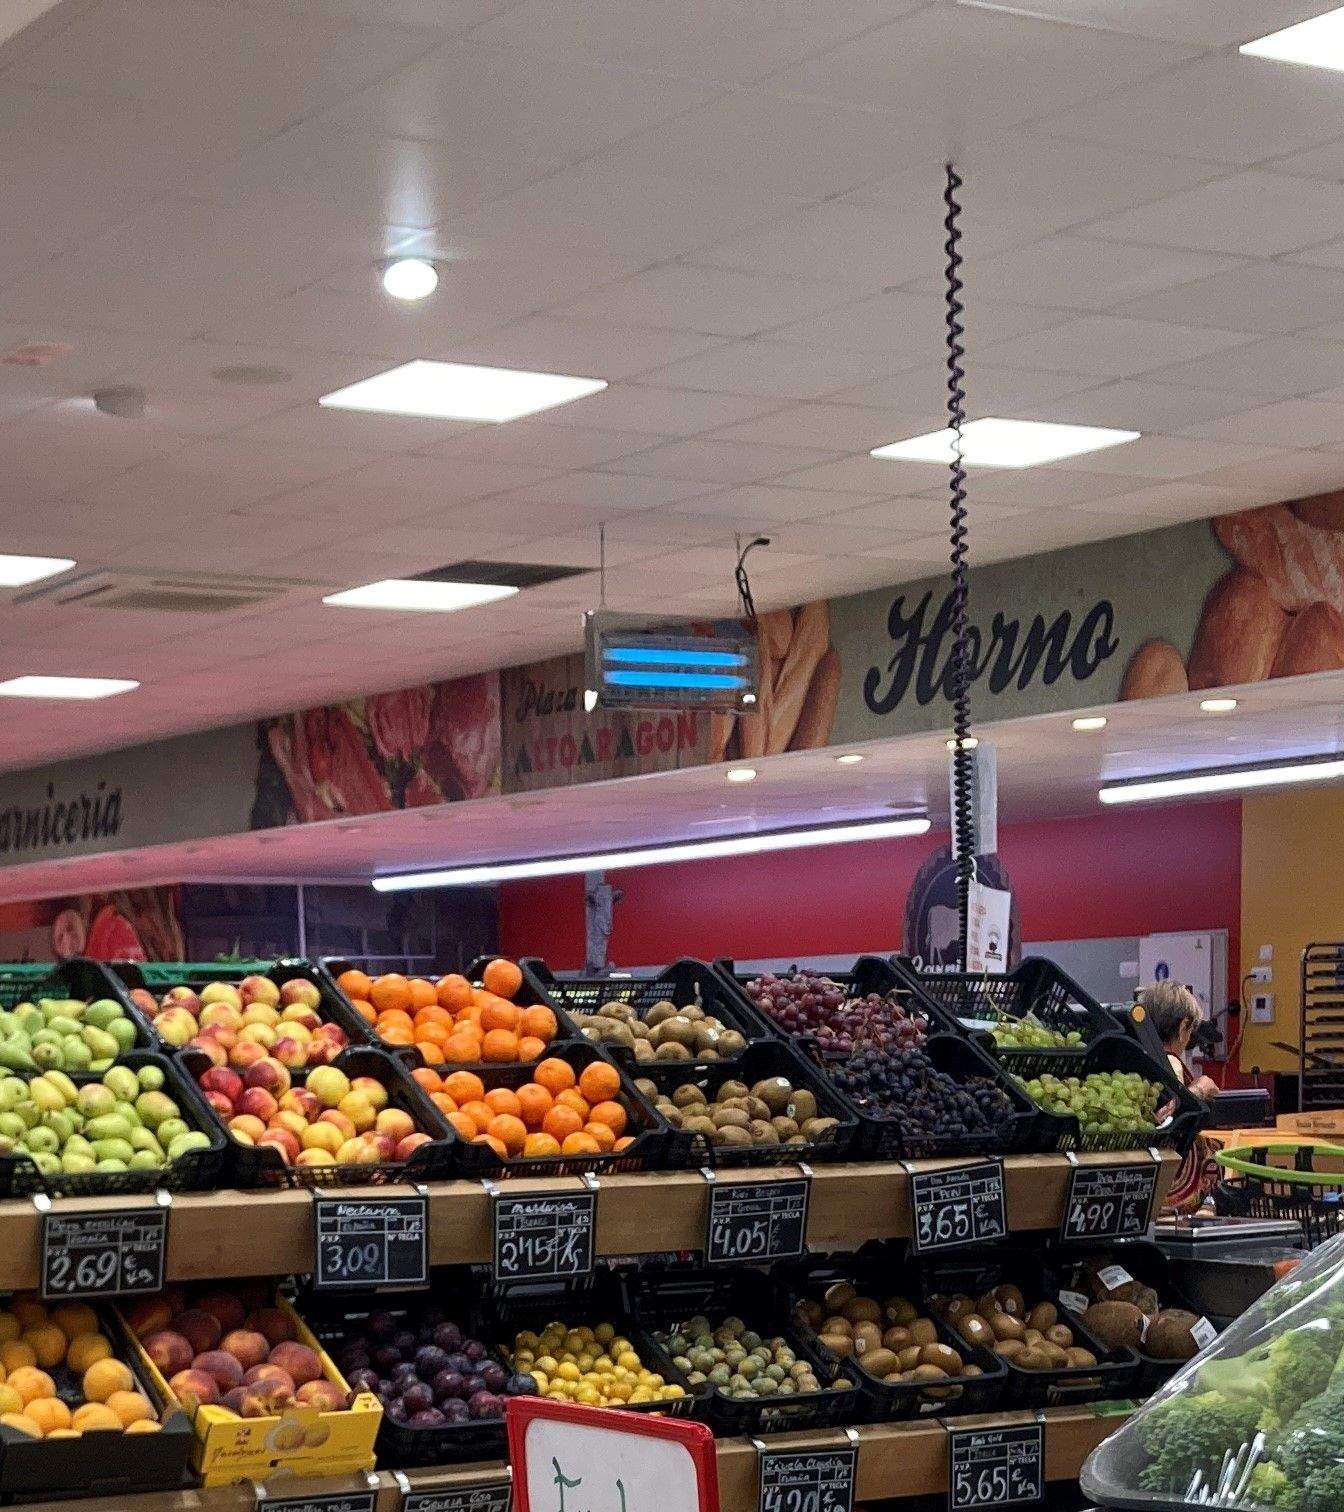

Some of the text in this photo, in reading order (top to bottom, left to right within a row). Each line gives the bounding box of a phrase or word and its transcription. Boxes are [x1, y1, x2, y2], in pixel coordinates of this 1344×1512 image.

[864, 587, 1120, 715] Horno
[50, 1251, 117, 1291] 2,69
[956, 1466, 1007, 1505] 5,65
